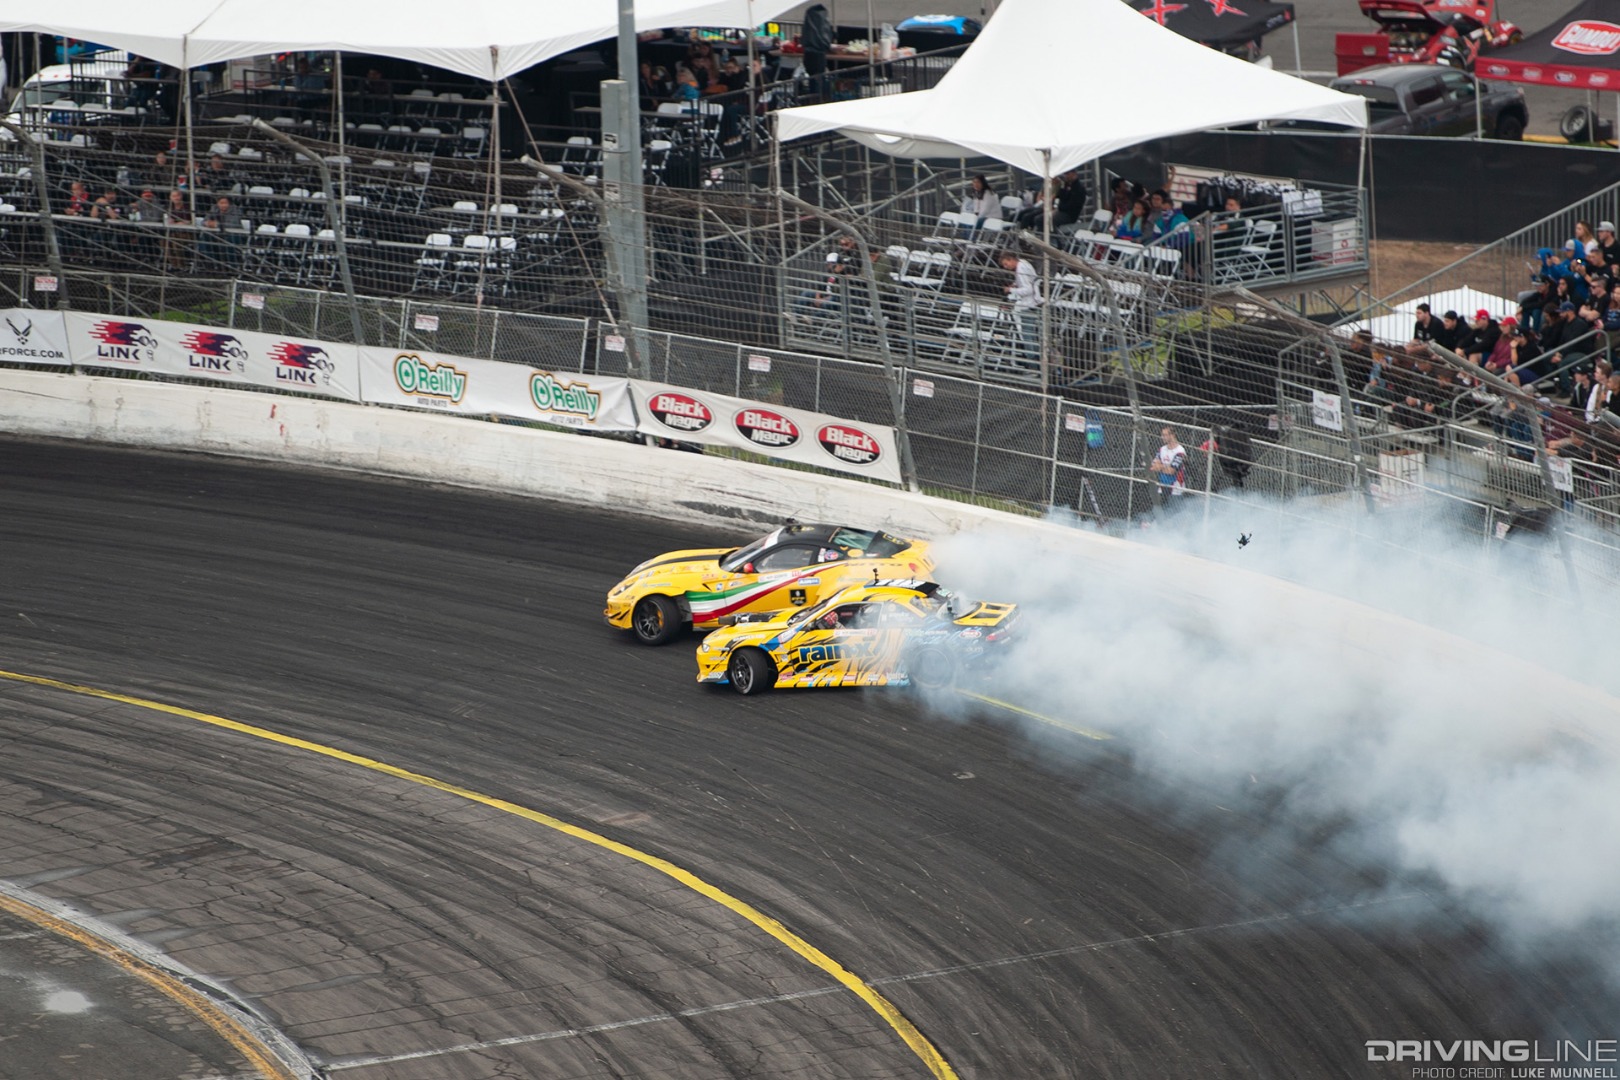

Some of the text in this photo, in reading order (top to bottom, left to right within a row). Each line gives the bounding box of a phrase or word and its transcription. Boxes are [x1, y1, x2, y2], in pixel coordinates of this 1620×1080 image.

[97, 344, 140, 360] LINK
[189, 354, 231, 372] LINK
[276, 366, 317, 384] LINK
[396, 355, 466, 402] O'Reilly
[531, 374, 600, 420] O'Reilly
[657, 395, 705, 417] Black
[665, 413, 705, 429] Magic
[743, 411, 791, 433] Black
[751, 428, 793, 446] Magic
[826, 427, 874, 451] Black
[834, 444, 875, 463] Magic
